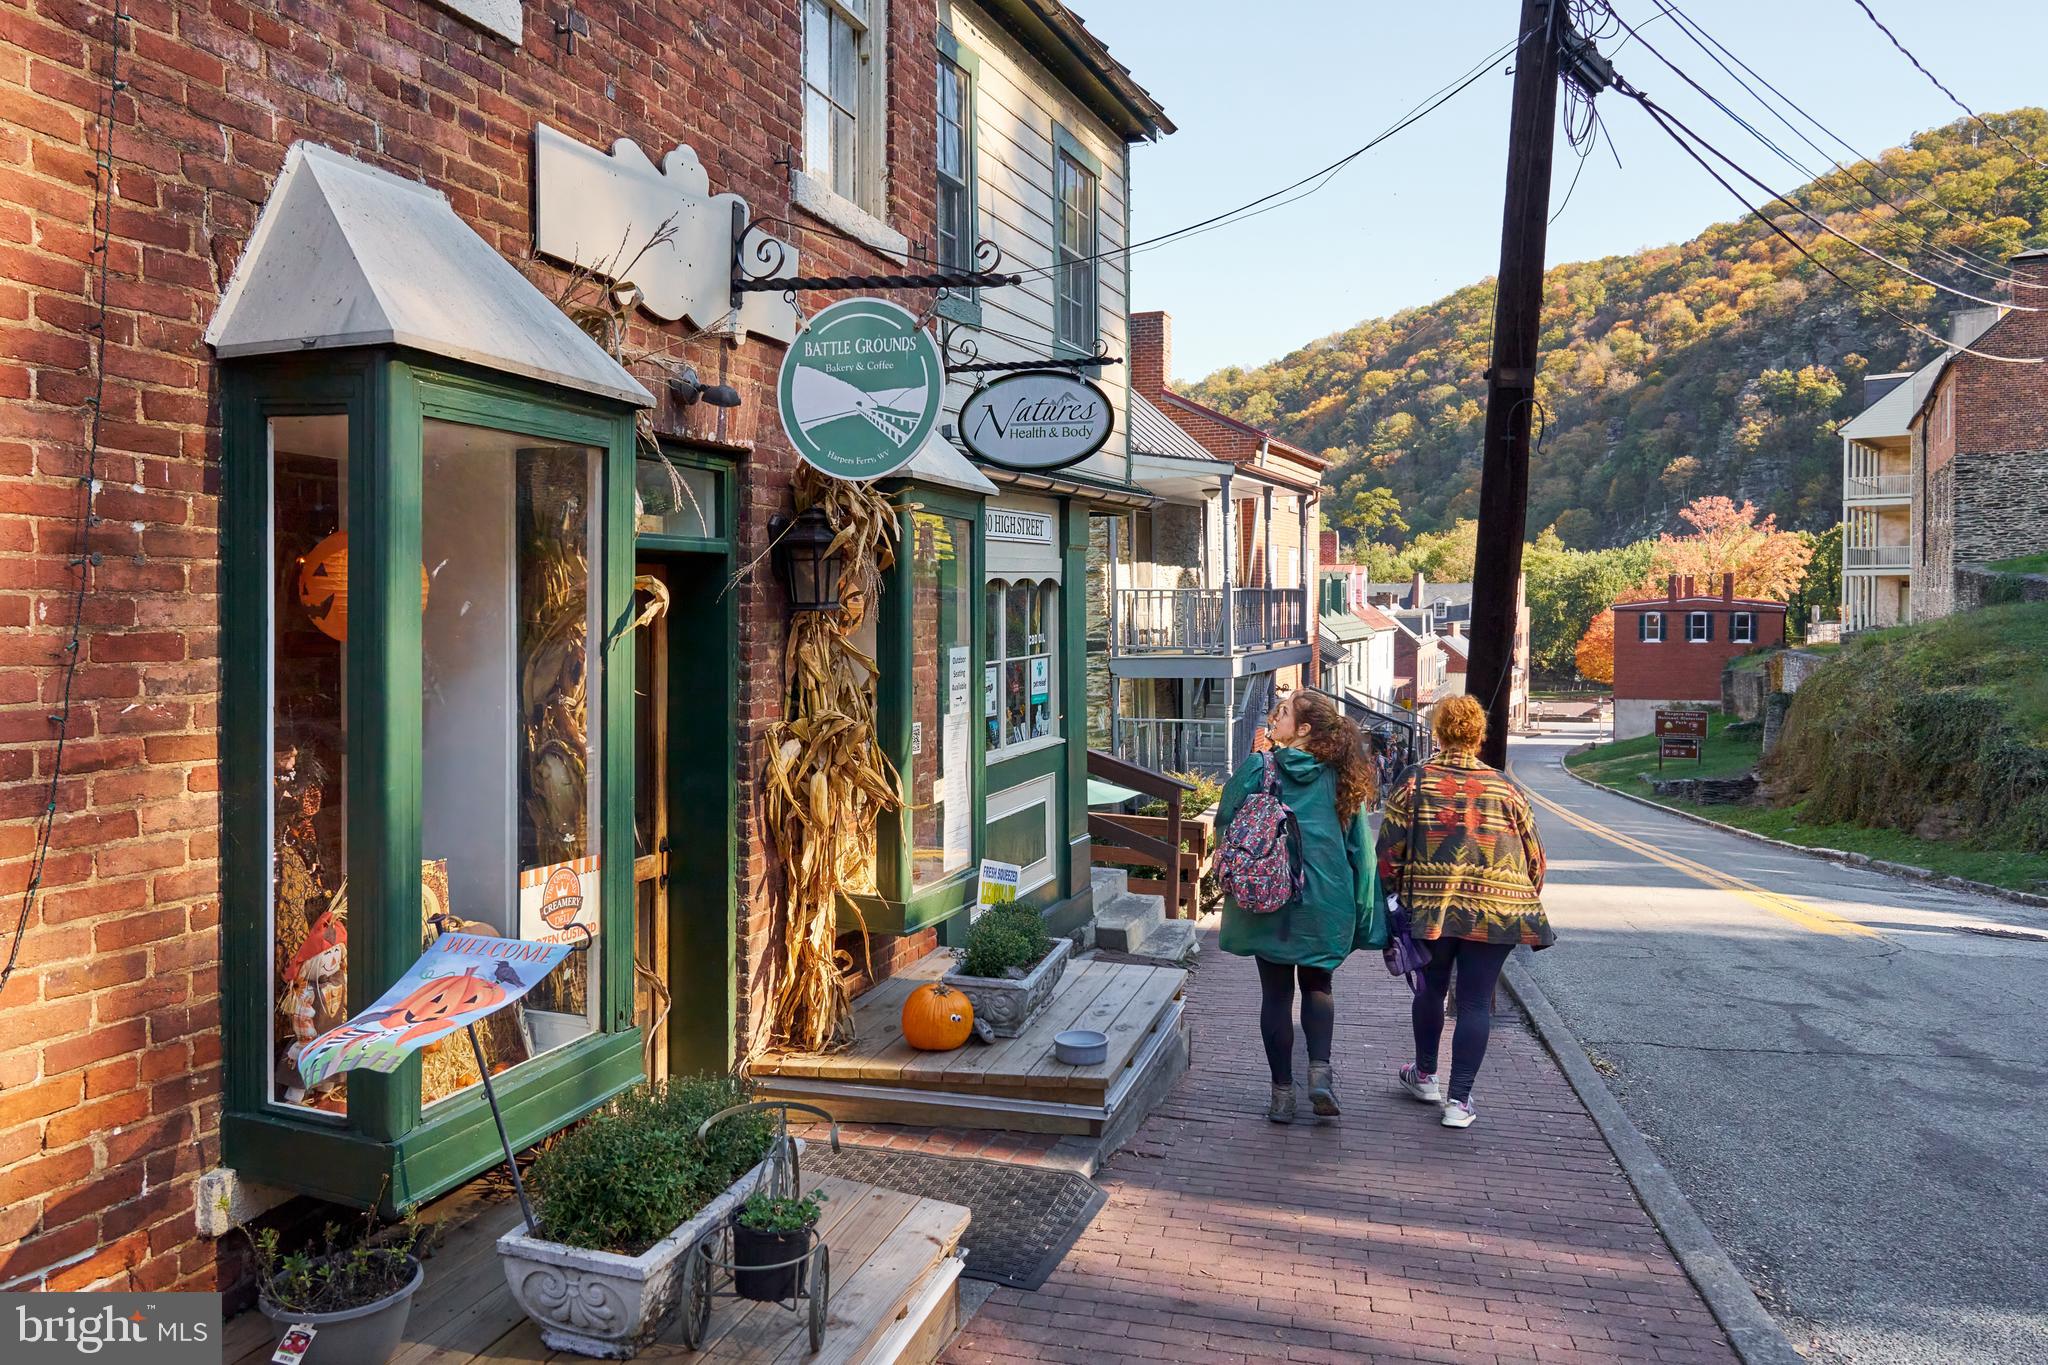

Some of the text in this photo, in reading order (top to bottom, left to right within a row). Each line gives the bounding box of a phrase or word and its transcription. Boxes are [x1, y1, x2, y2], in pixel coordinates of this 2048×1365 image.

[804, 336, 917, 357] BATTLE GROUNDS
[825, 359, 894, 373] Bakery & Coffee
[974, 396, 1097, 441] Natures
[1009, 424, 1094, 440] Health & Body
[827, 450, 855, 464] Harpers
[877, 449, 889, 460] WV
[994, 514, 1016, 534] HIGH
[1016, 516, 1044, 537] STREET
[983, 865, 1018, 882] FRESH SQUEEZED
[543, 896, 581, 916] CREAMERY
[443, 936, 558, 963] WELCOME
